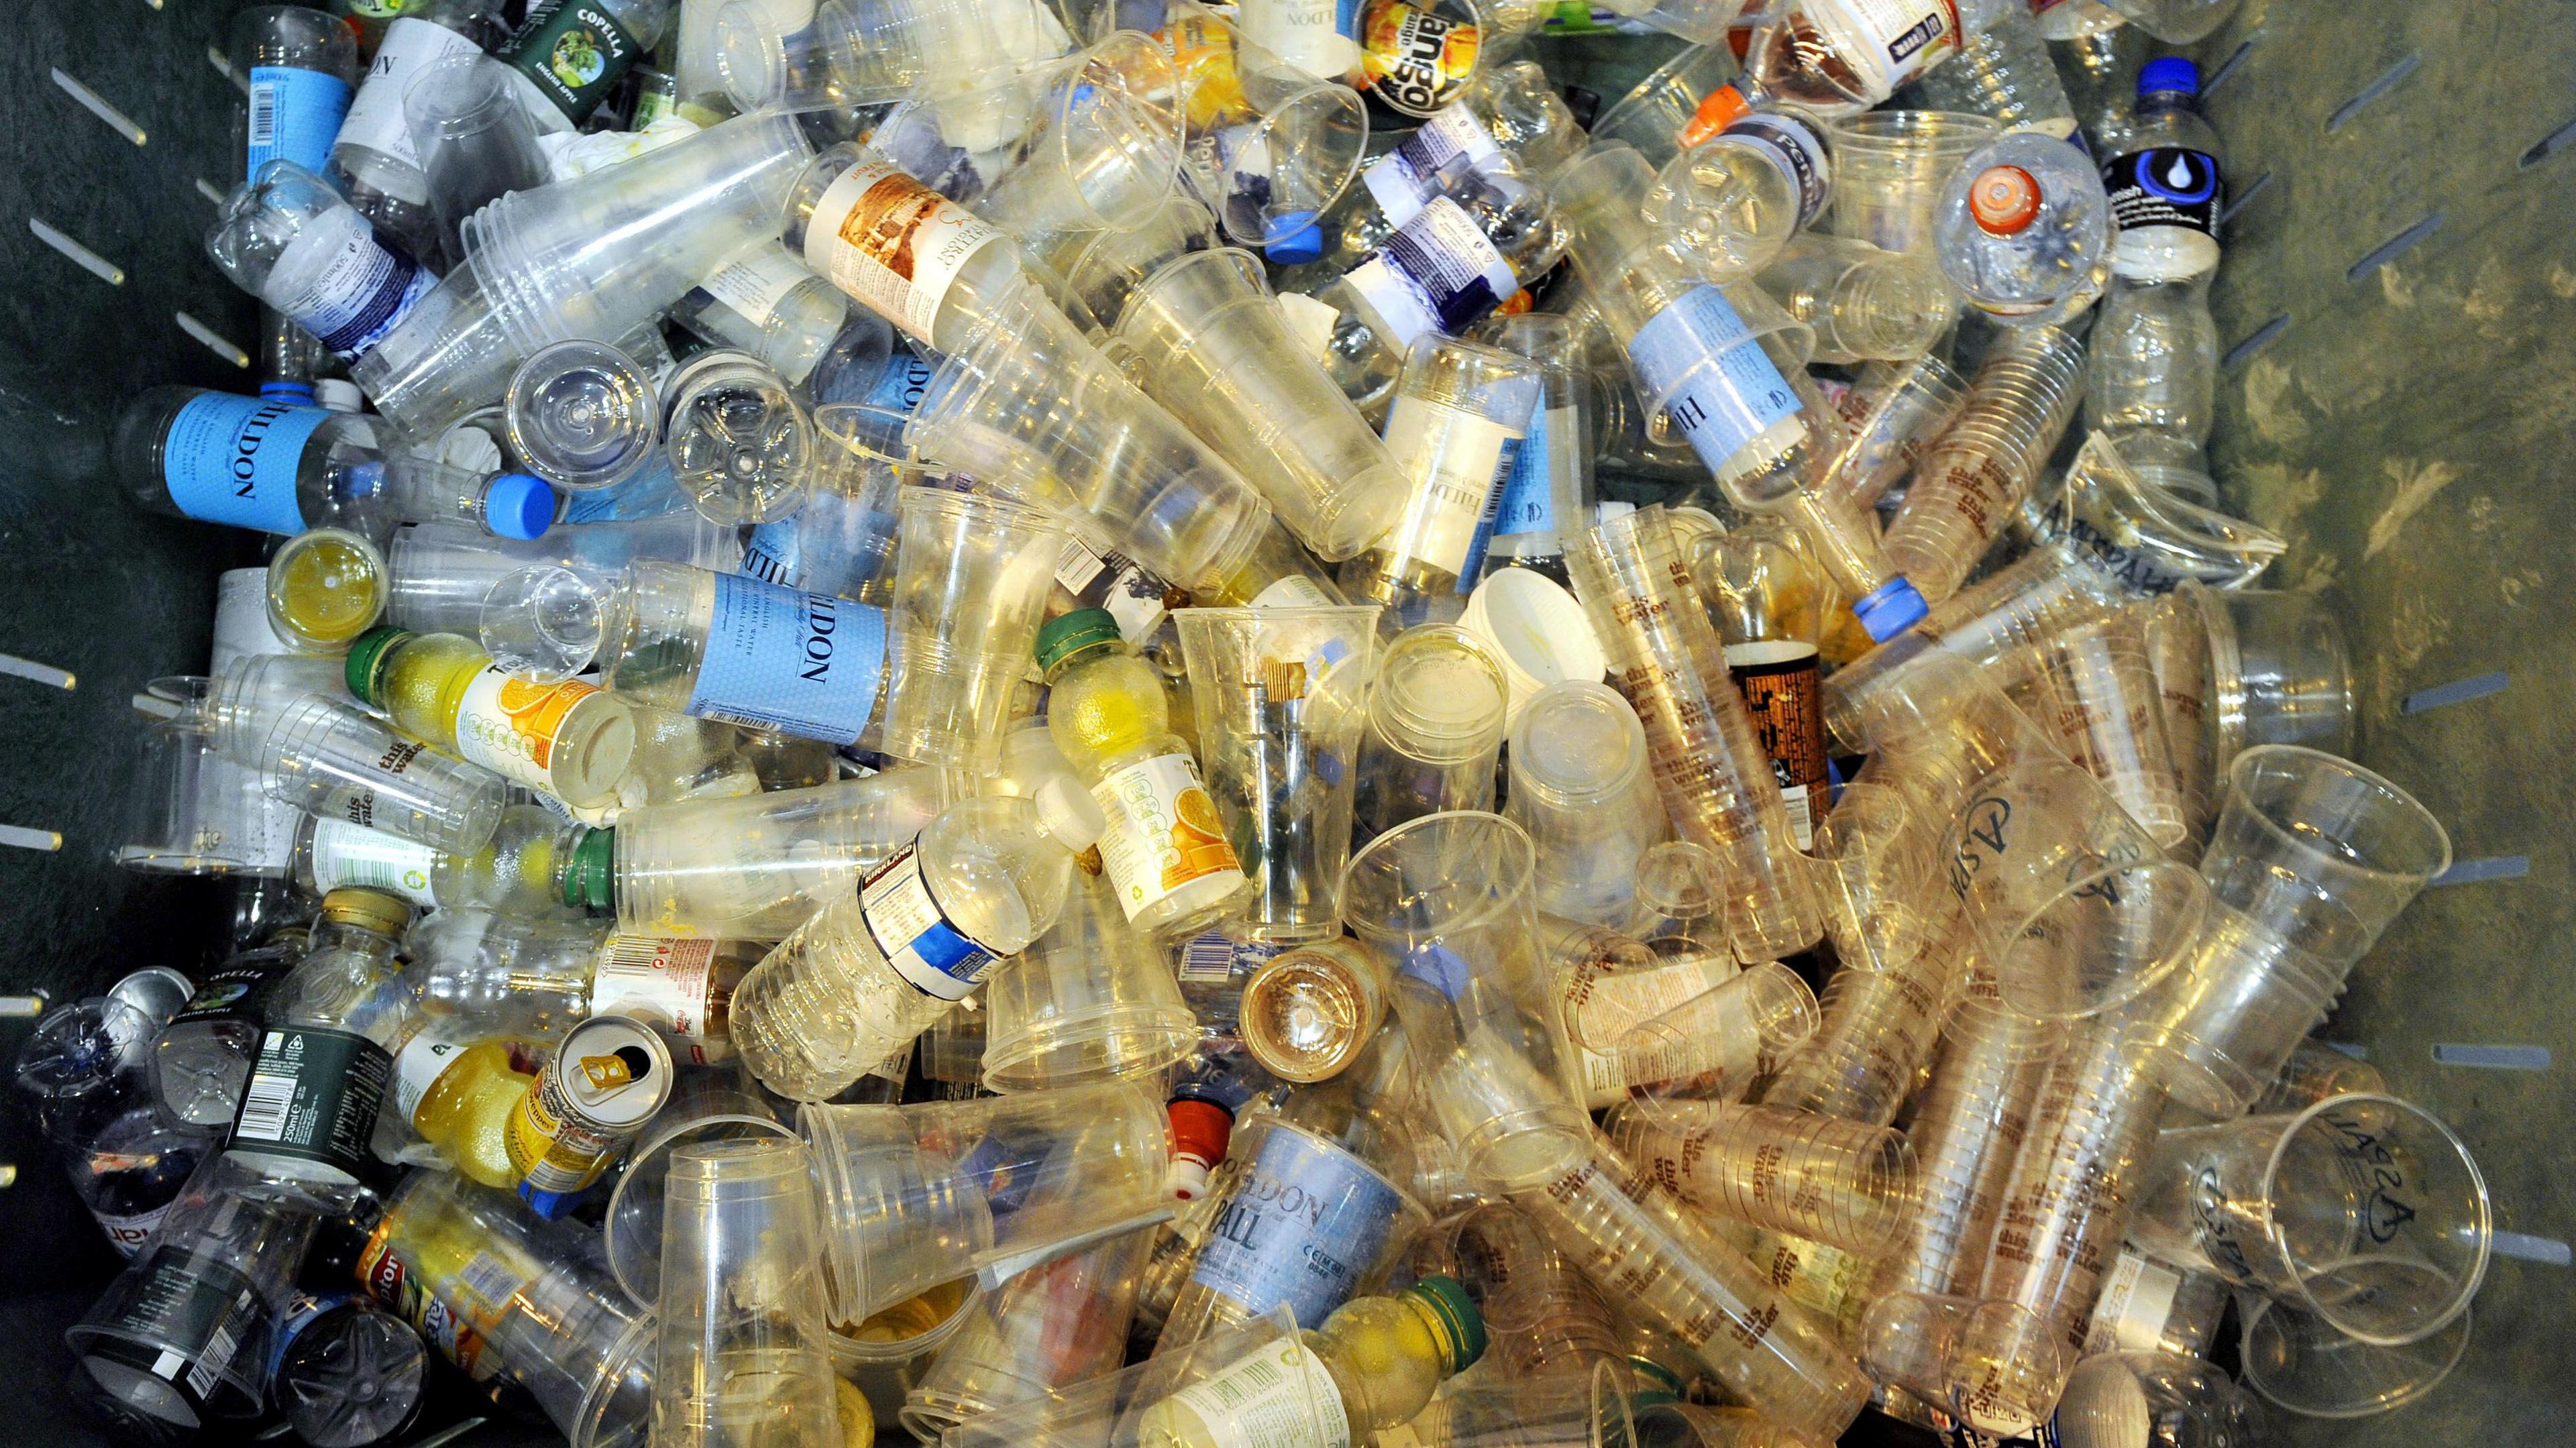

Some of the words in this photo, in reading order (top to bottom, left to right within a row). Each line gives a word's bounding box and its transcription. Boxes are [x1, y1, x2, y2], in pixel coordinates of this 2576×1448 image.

[577, 9, 624, 58] COPELLA
[535, 62, 562, 87] ENGLISH
[558, 83, 578, 104] APPLE
[747, 628, 756, 657] WATER
[378, 741, 409, 770] this
[392, 740, 428, 774] water
[865, 843, 913, 884] KIRKLAND
[209, 970, 264, 981] OPELLA
[380, 1254, 400, 1304] pton
